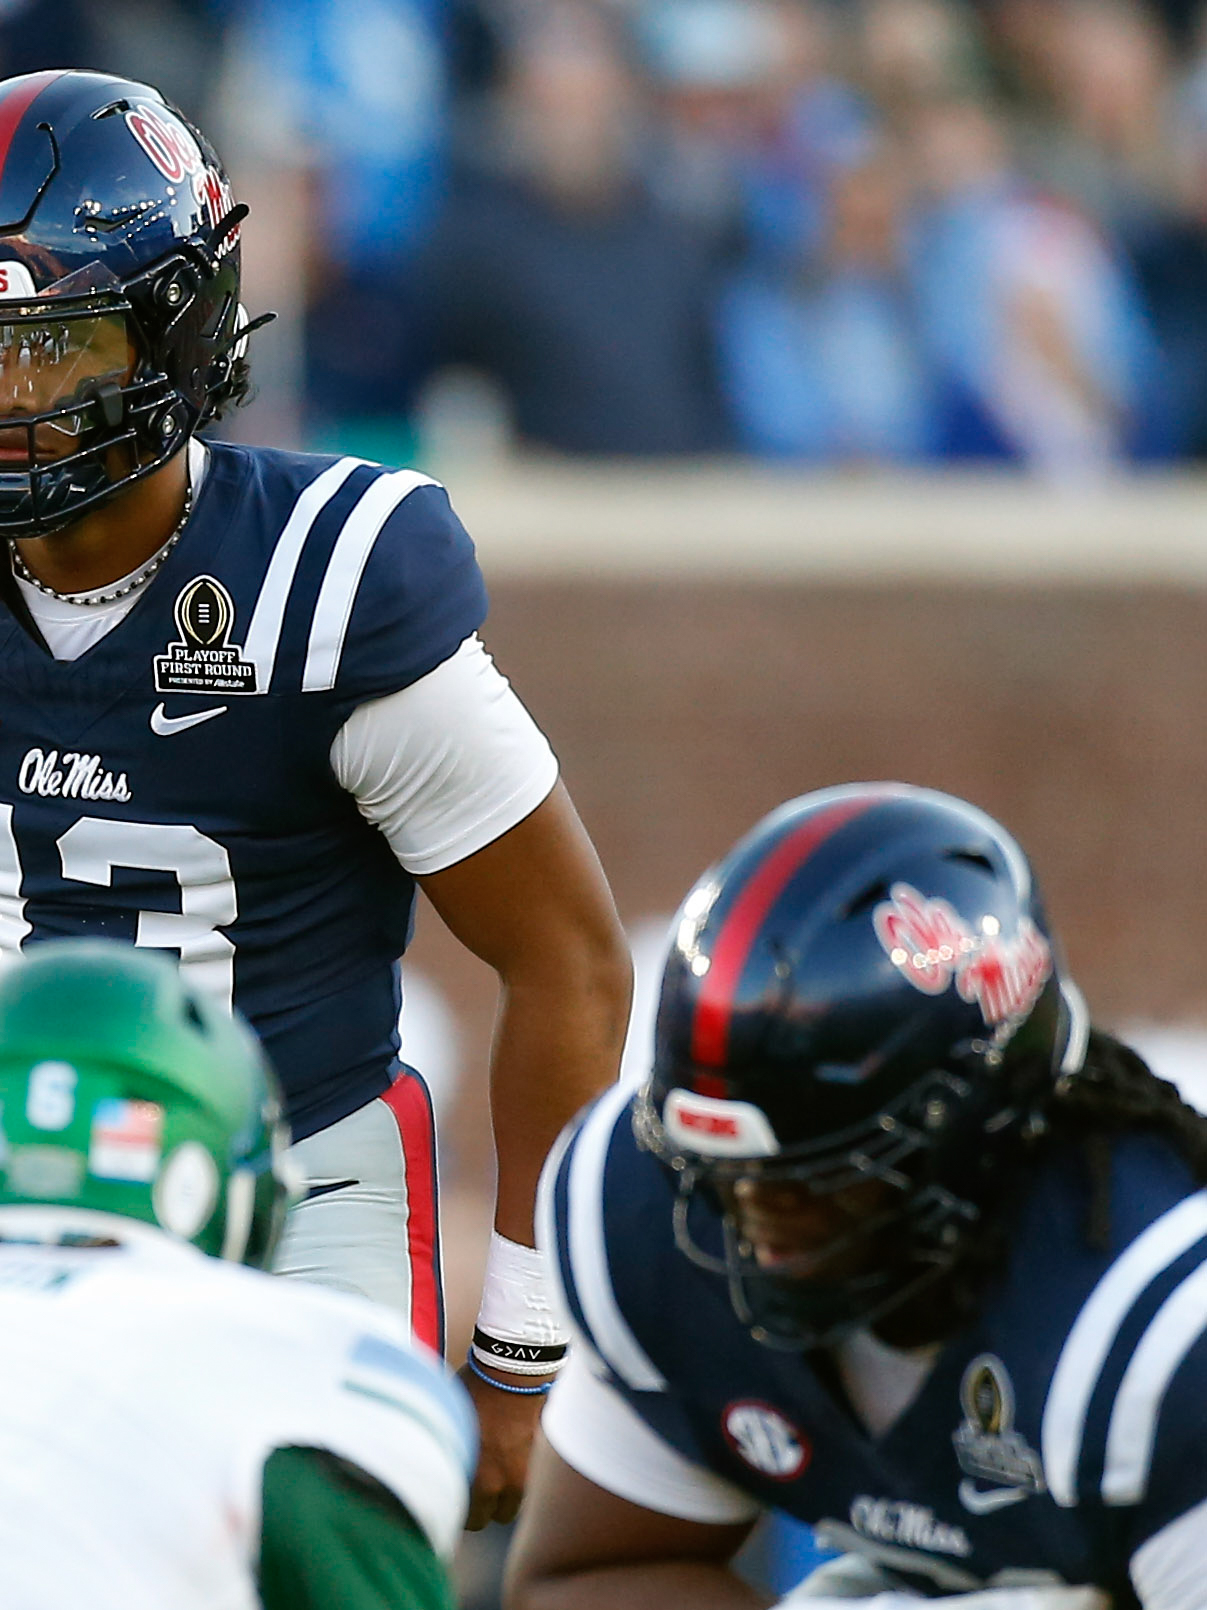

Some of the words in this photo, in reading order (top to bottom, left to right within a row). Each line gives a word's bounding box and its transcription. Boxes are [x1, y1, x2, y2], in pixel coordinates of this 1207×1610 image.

[160, 661, 202, 675] FIRST
[204, 663, 252, 677] ROUND
[175, 648, 236, 663] PLAYOFF
[18, 748, 63, 798] Ole
[61, 752, 132, 802] Miss
[26, 1060, 78, 1132] 6
